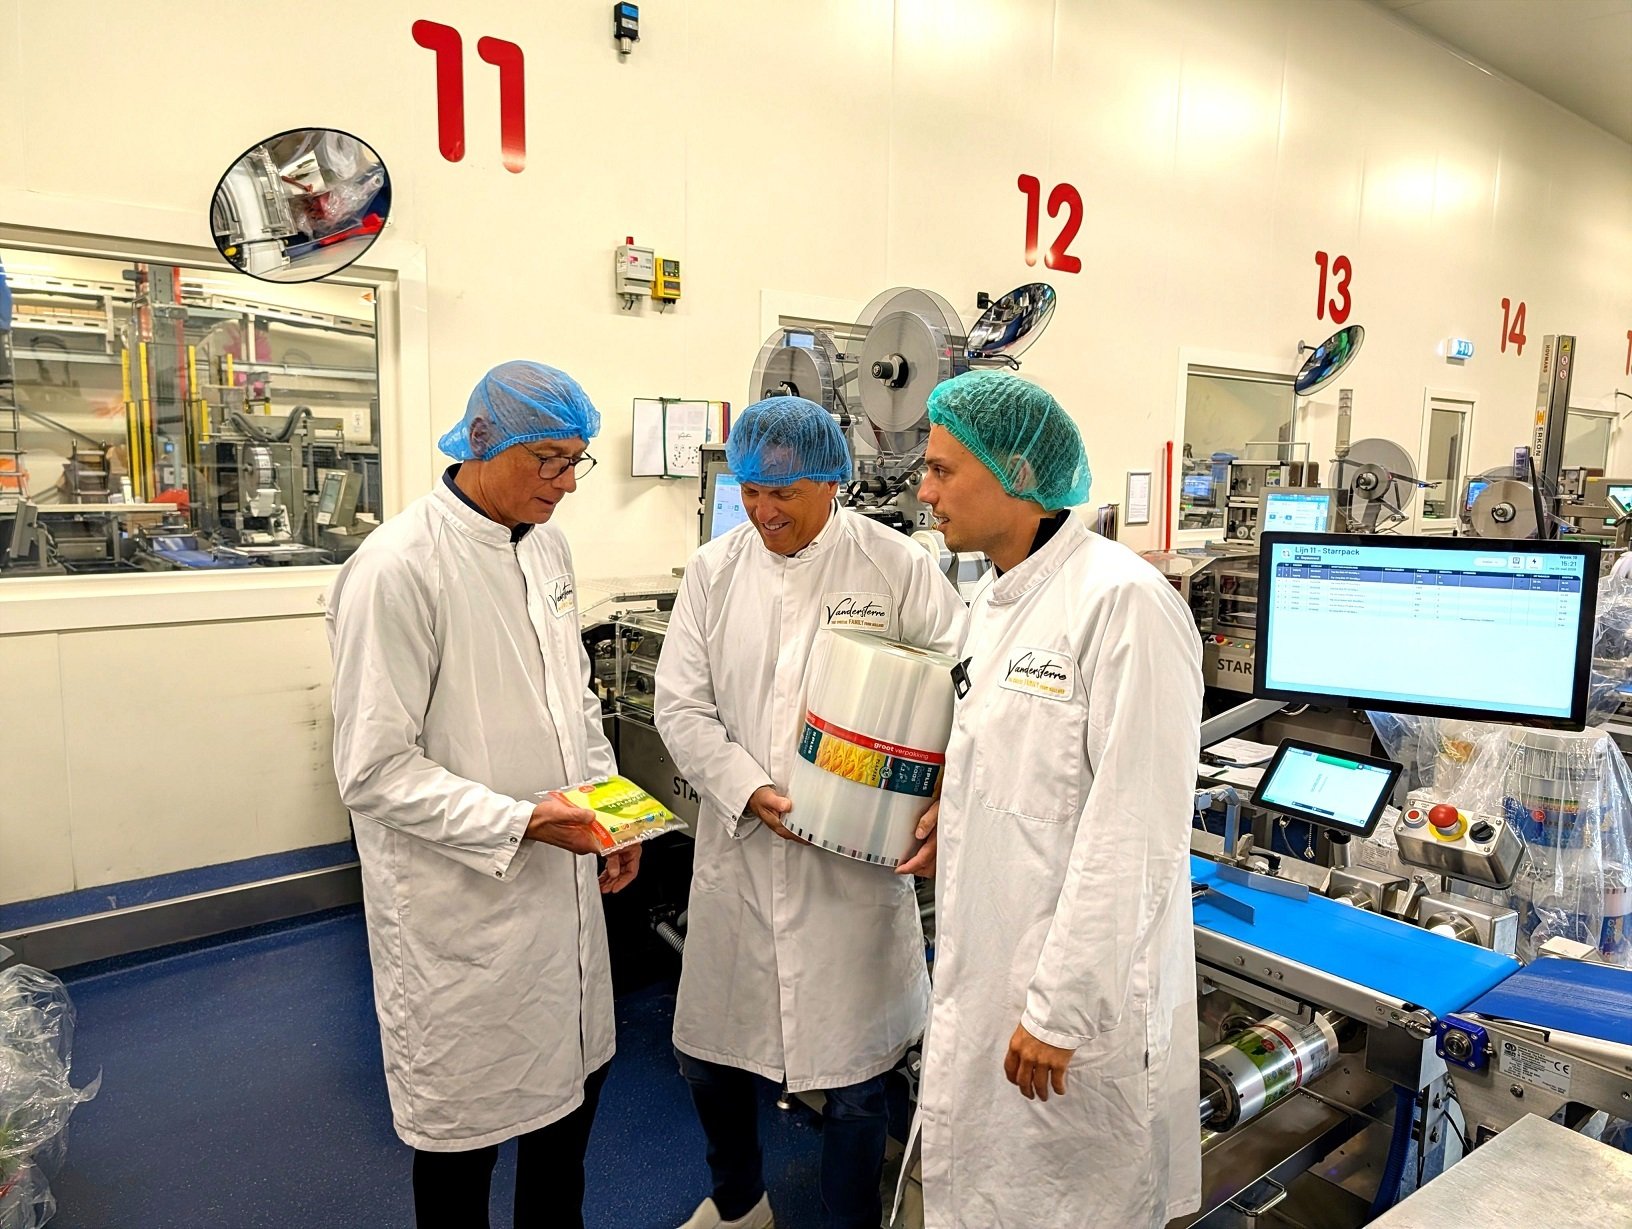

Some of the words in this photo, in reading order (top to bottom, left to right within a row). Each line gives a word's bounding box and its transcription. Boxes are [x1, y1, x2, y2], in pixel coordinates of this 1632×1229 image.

[412, 19, 526, 174] 11
[1018, 174, 1083, 274] 12
[1315, 251, 1352, 324] 13
[1501, 298, 1526, 356] 14
[1626, 329, 1632, 376] 1
[919, 512, 926, 526] 2
[1295, 546, 1309, 555] Lijn
[1322, 547, 1360, 556] Starrpack
[825, 597, 886, 625] Vandersterre
[1004, 651, 1067, 681] Vandersterre
[1217, 658, 1253, 675] STAR
[873, 742, 895, 752] groot
[894, 748, 930, 761] verpakking
[911, 765, 921, 782] kaas
[673, 776, 702, 804] STA
